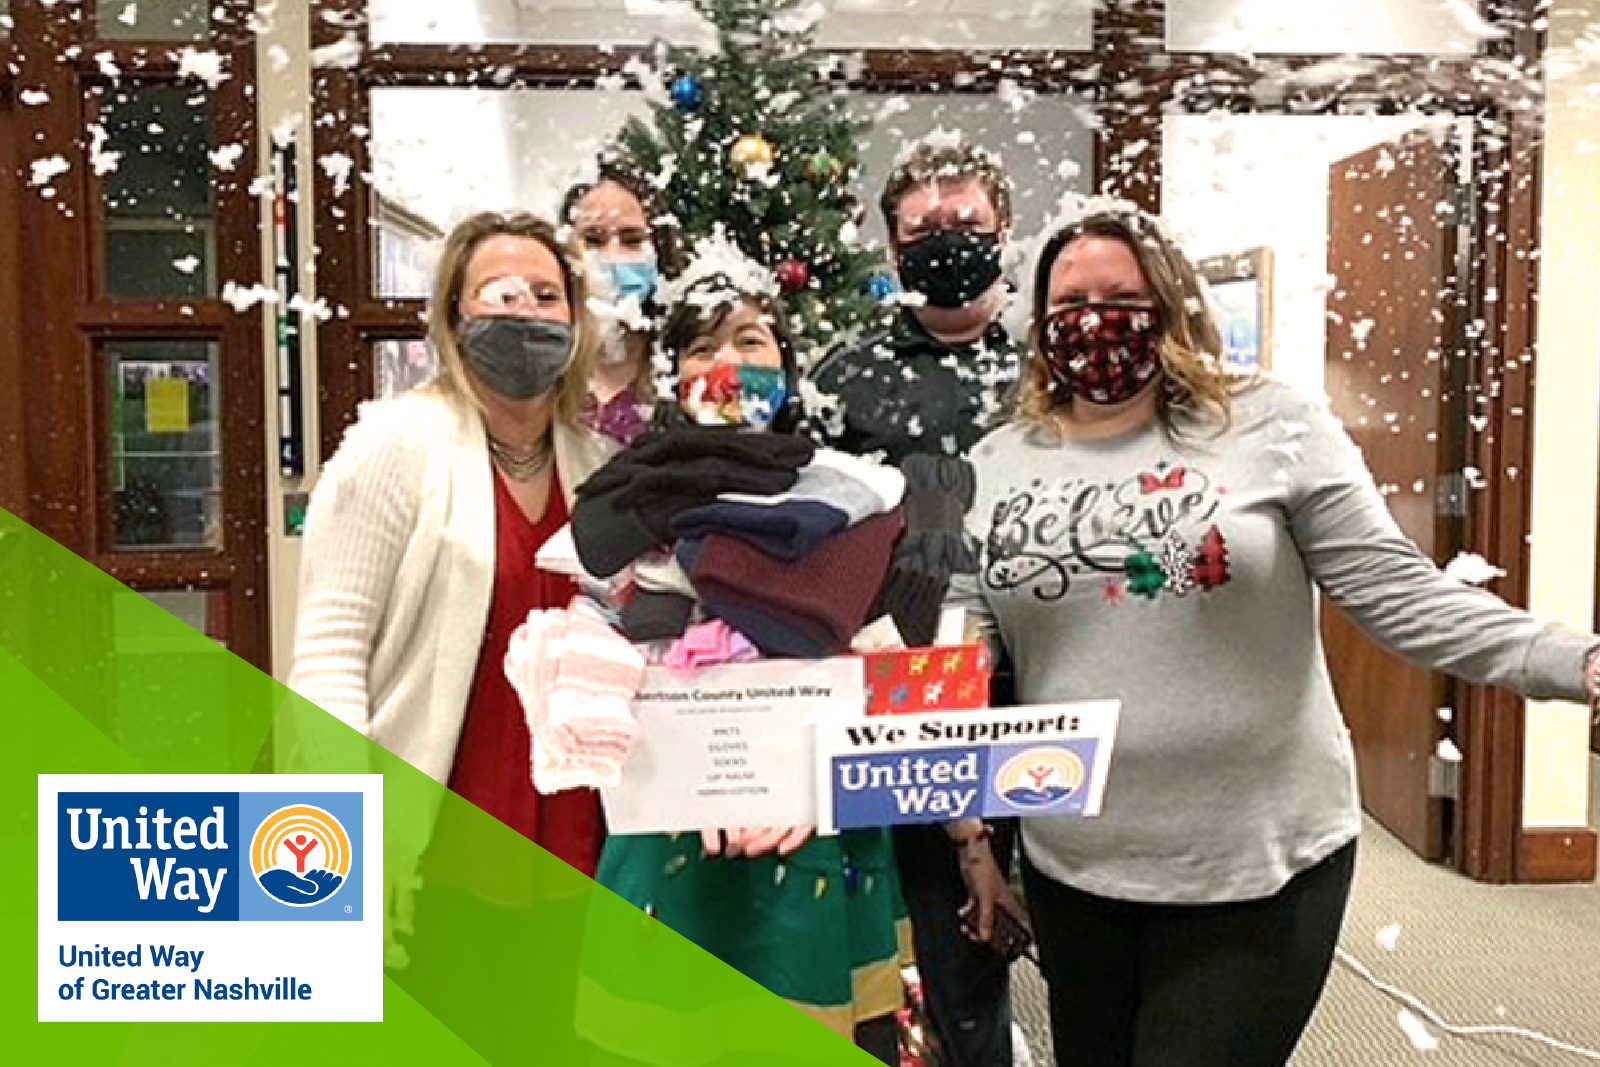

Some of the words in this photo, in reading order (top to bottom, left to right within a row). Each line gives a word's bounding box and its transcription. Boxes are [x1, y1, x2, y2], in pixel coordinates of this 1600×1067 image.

[986, 484, 1206, 576] Believe
[691, 688, 743, 701] County
[746, 685, 796, 699] United
[797, 685, 832, 698] Way
[846, 723, 907, 746] We
[918, 713, 1081, 741] Support:
[839, 753, 978, 790] United
[895, 785, 977, 817] Way
